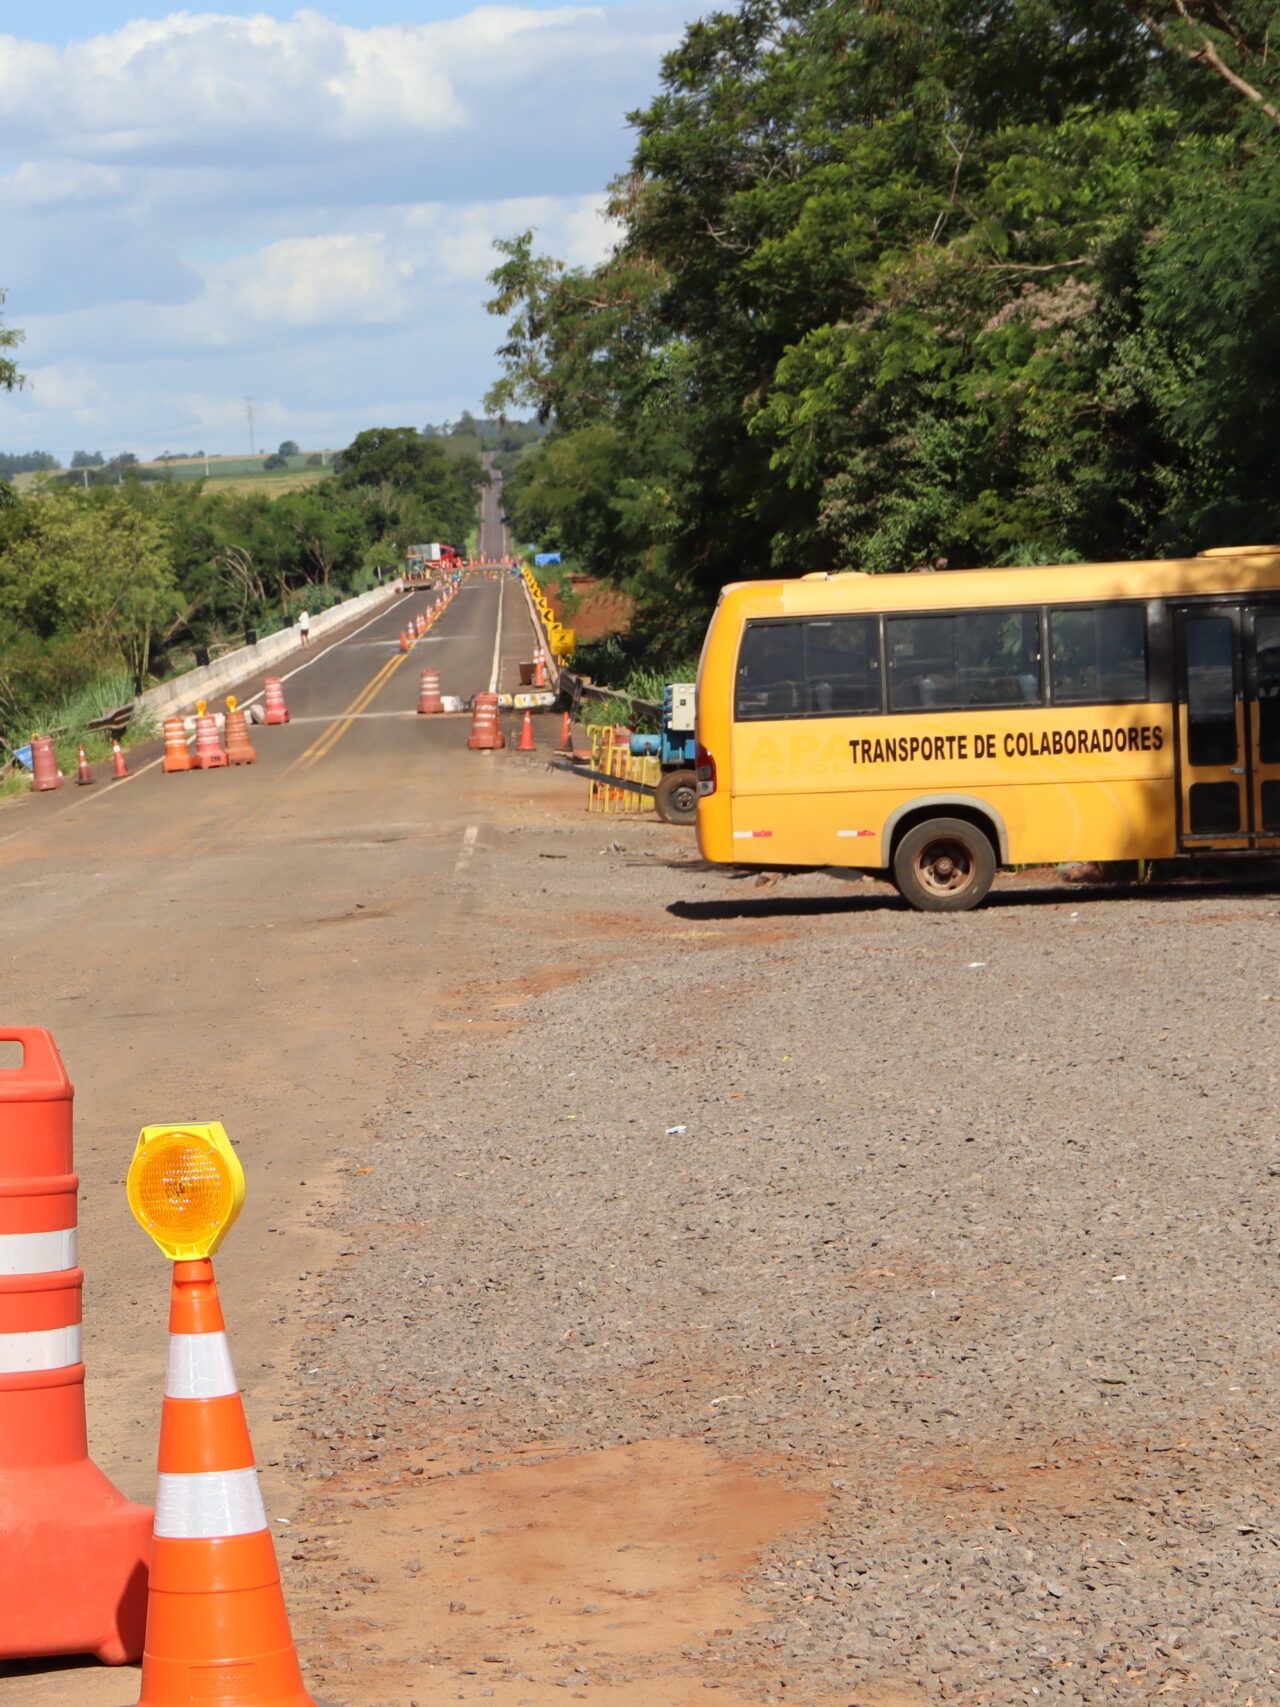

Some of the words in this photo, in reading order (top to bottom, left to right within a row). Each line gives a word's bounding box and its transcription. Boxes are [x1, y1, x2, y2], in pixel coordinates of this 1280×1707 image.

[849, 735, 968, 764] TRANSPORTE
[974, 734, 996, 759] DE
[1003, 725, 1164, 758] COLABORADORES
